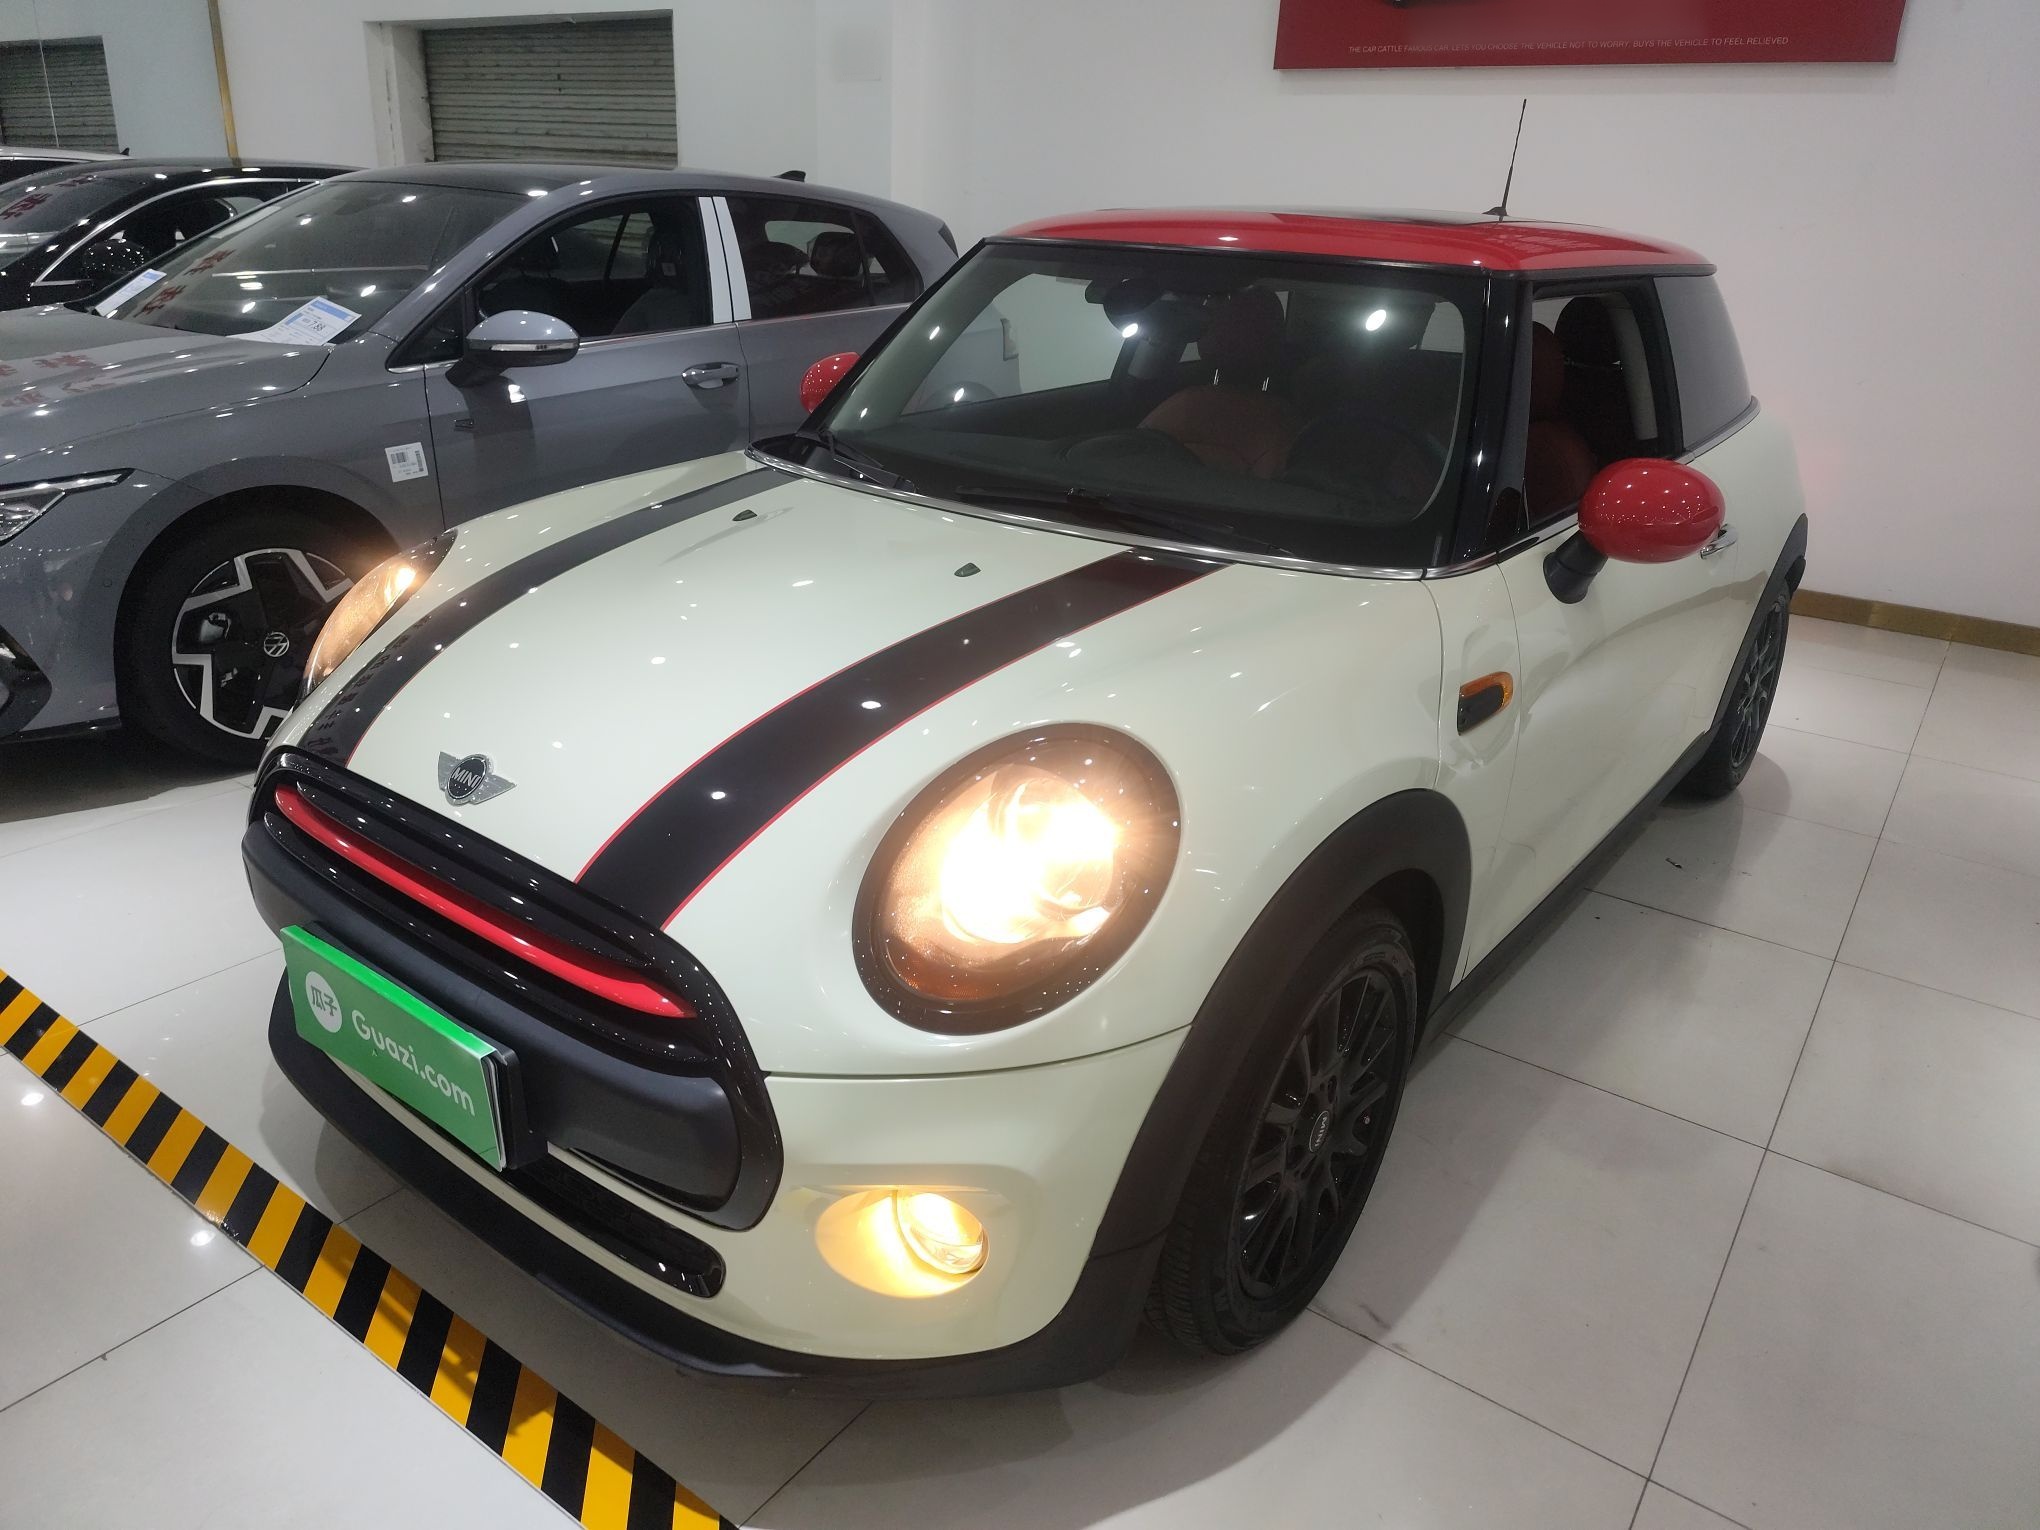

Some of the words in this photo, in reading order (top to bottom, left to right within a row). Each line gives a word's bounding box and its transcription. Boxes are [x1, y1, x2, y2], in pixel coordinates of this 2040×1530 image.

[1487, 42, 1518, 50] CHOOSE
[1536, 41, 1568, 49] VEHICLE
[1632, 39, 1655, 48] BUYS
[1657, 39, 1672, 47] THE
[1674, 38, 1709, 47] VEHICLE
[1711, 38, 1723, 46] TO
[1724, 37, 1745, 46] FEEL
[1746, 36, 1789, 45] RELIEVED
[451, 767, 481, 788] MINI
[311, 985, 337, 1016] 瓜子
[352, 1010, 475, 1116] Guazi.com
[1315, 1116, 1328, 1147] MINI
